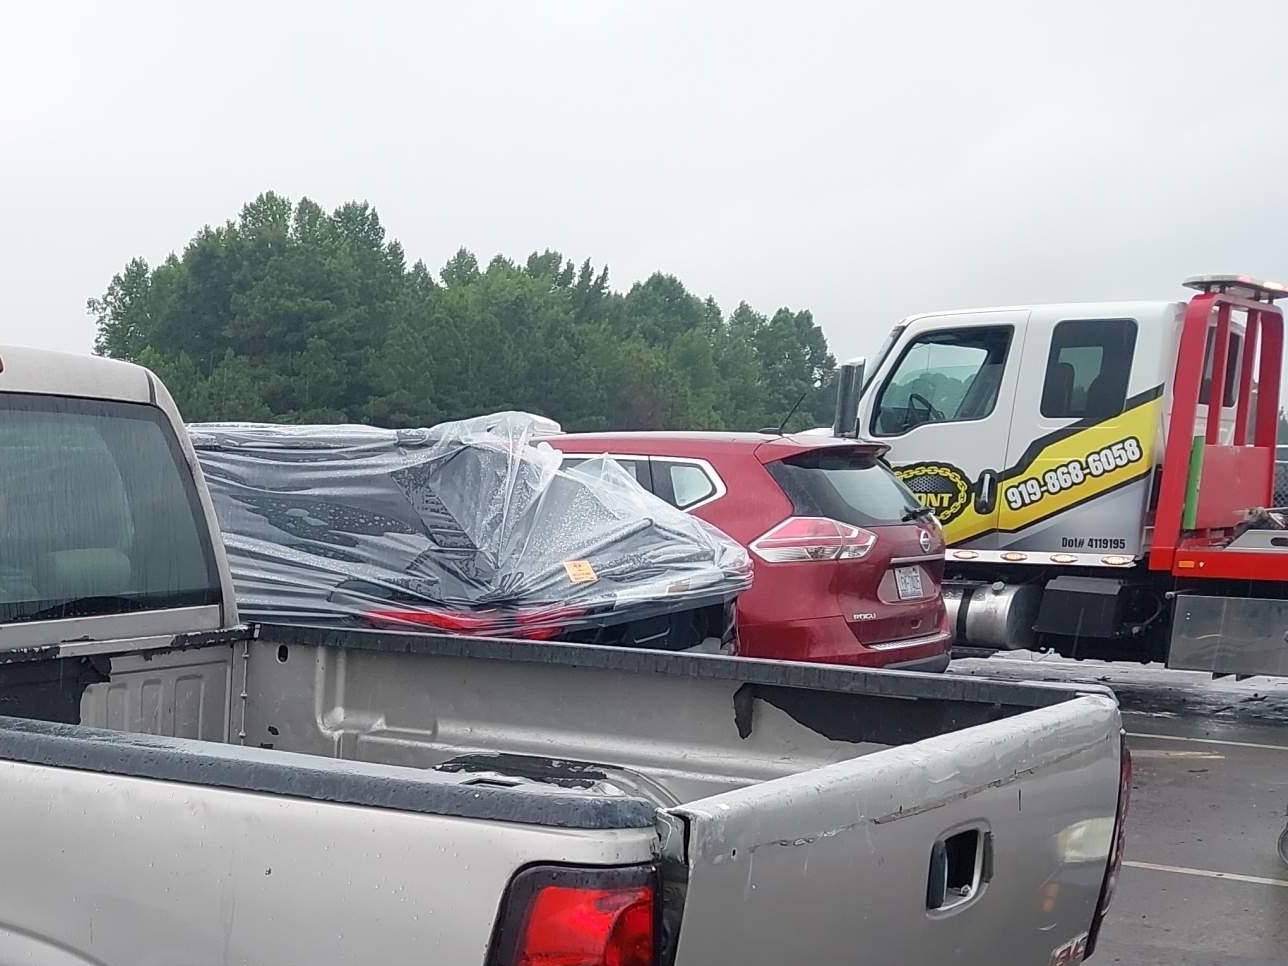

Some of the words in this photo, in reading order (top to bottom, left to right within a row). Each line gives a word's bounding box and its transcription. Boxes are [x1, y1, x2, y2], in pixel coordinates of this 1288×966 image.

[1005, 437, 1142, 510] 919-868-6058
[915, 492, 953, 507] ONT
[1061, 537, 1086, 548] Dot#
[1088, 538, 1126, 550] 4119195
